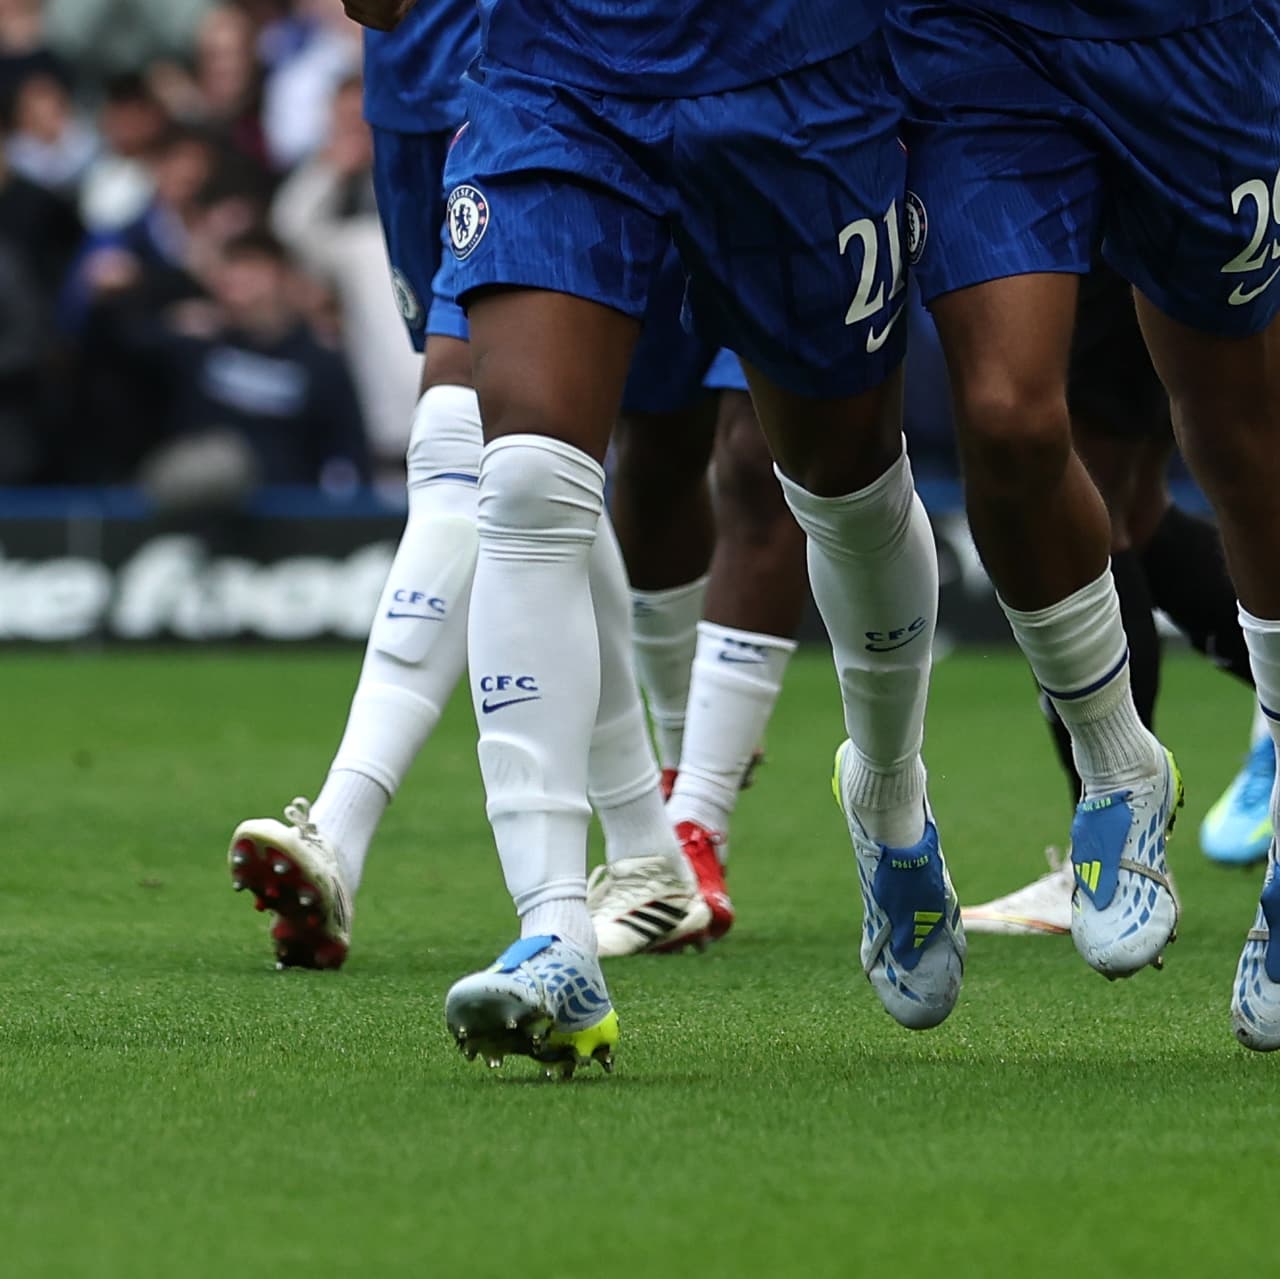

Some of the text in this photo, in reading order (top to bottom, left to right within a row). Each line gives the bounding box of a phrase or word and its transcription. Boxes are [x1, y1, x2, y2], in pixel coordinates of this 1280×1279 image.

[838, 197, 905, 325] 21
[393, 589, 446, 615] CFC
[865, 616, 926, 642] CFC
[480, 675, 539, 692] CFC
